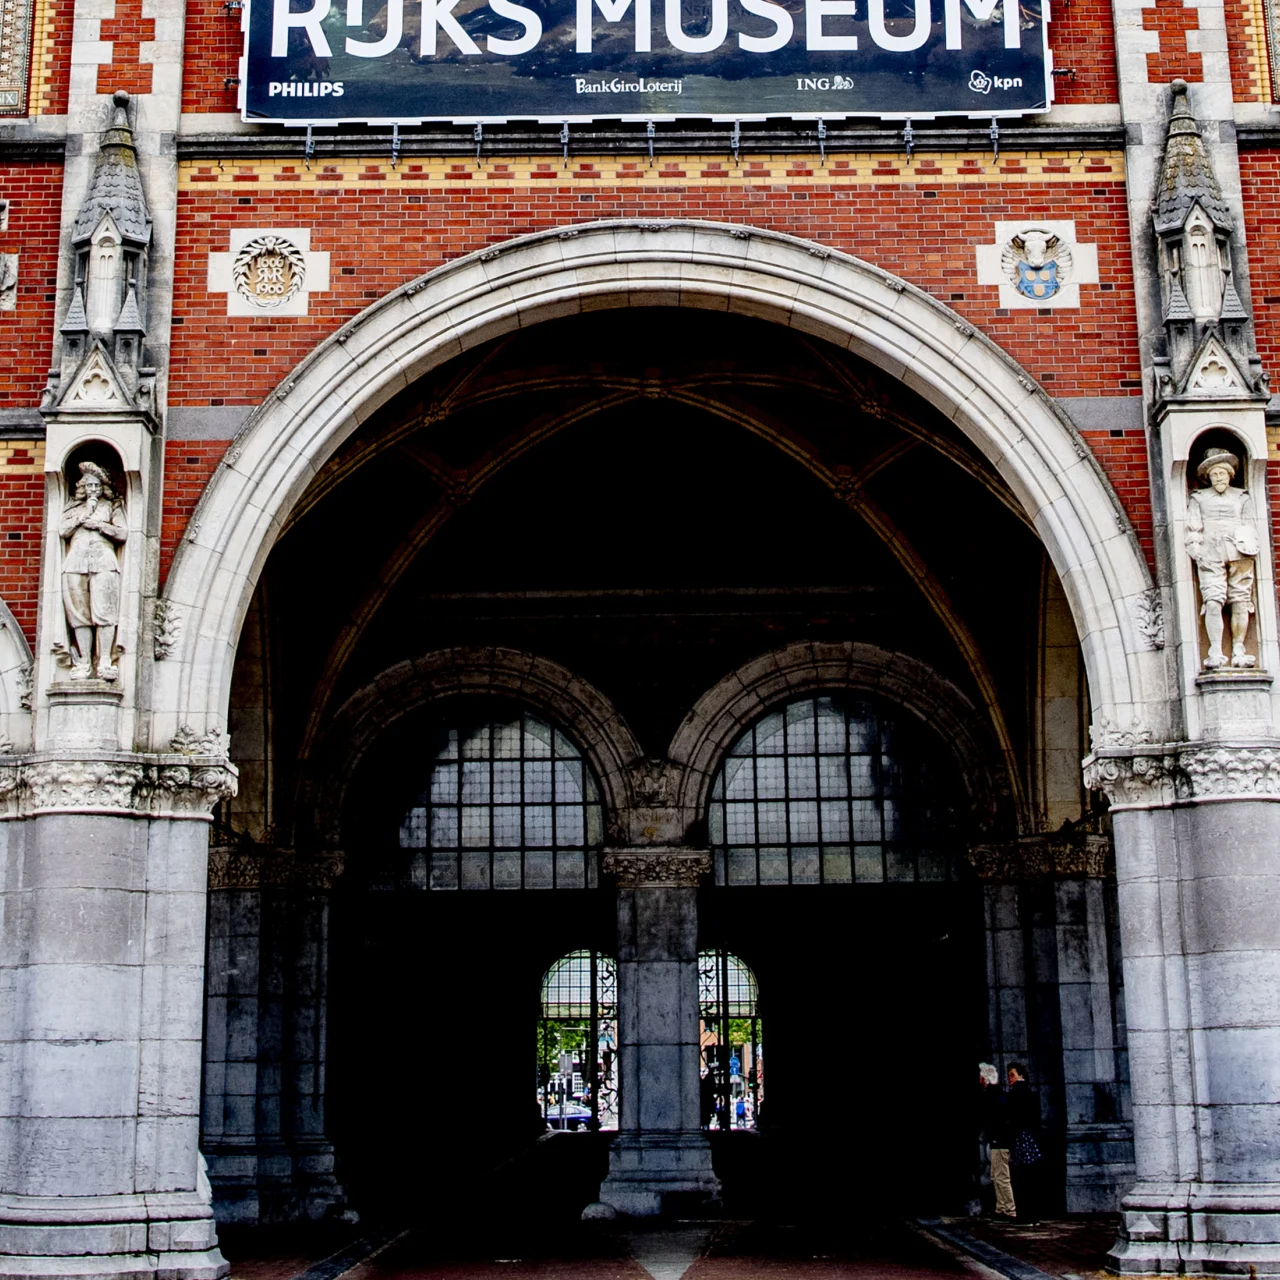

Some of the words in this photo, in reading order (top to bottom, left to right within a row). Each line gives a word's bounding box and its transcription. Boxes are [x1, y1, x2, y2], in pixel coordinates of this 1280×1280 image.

[575, 77, 683, 95] BankGiroLoterij
[796, 77, 830, 91] ING
[993, 75, 1023, 89] kpn
[269, 82, 344, 97] PHILIPS
[256, 256, 285, 268] 1606
